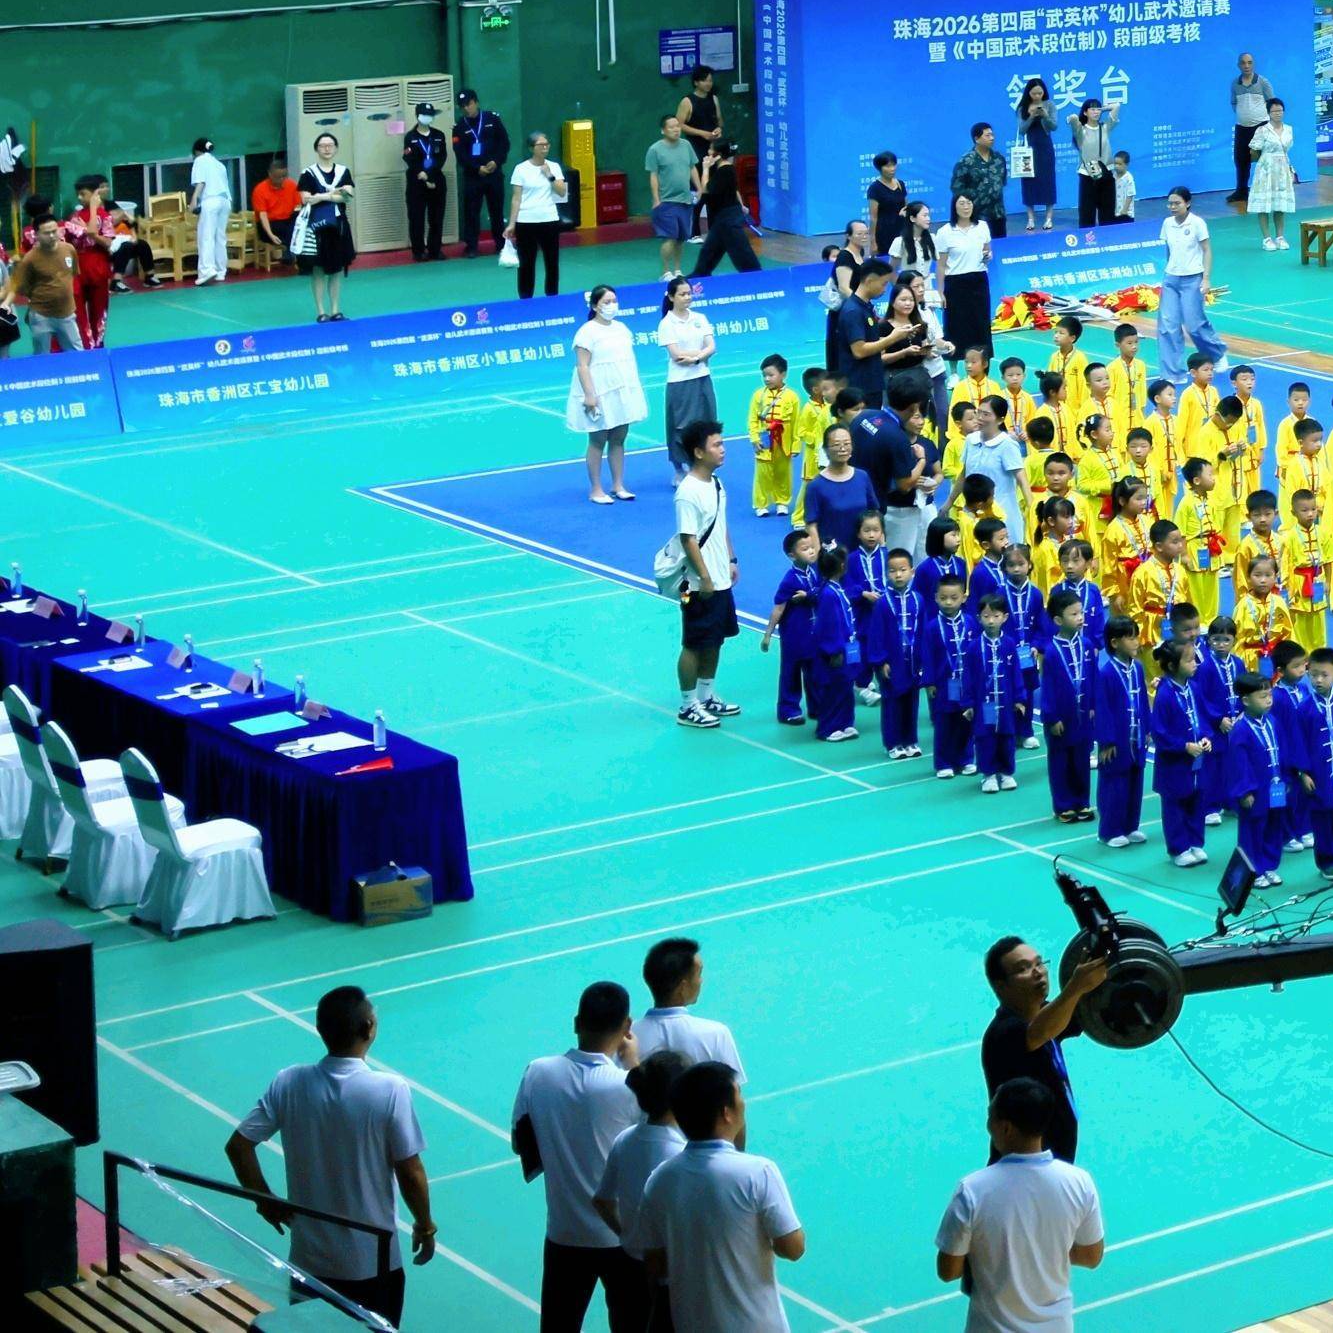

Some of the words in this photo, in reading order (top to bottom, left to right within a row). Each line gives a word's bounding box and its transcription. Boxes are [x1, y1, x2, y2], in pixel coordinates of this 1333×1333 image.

[928, 22, 1201, 63] 暨《中国武术段位制》段前级考核
[158, 373, 330, 409] 珠海市香洲区汇宝幼儿园
[0, 402, 86, 427] 爱谷幼儿园
